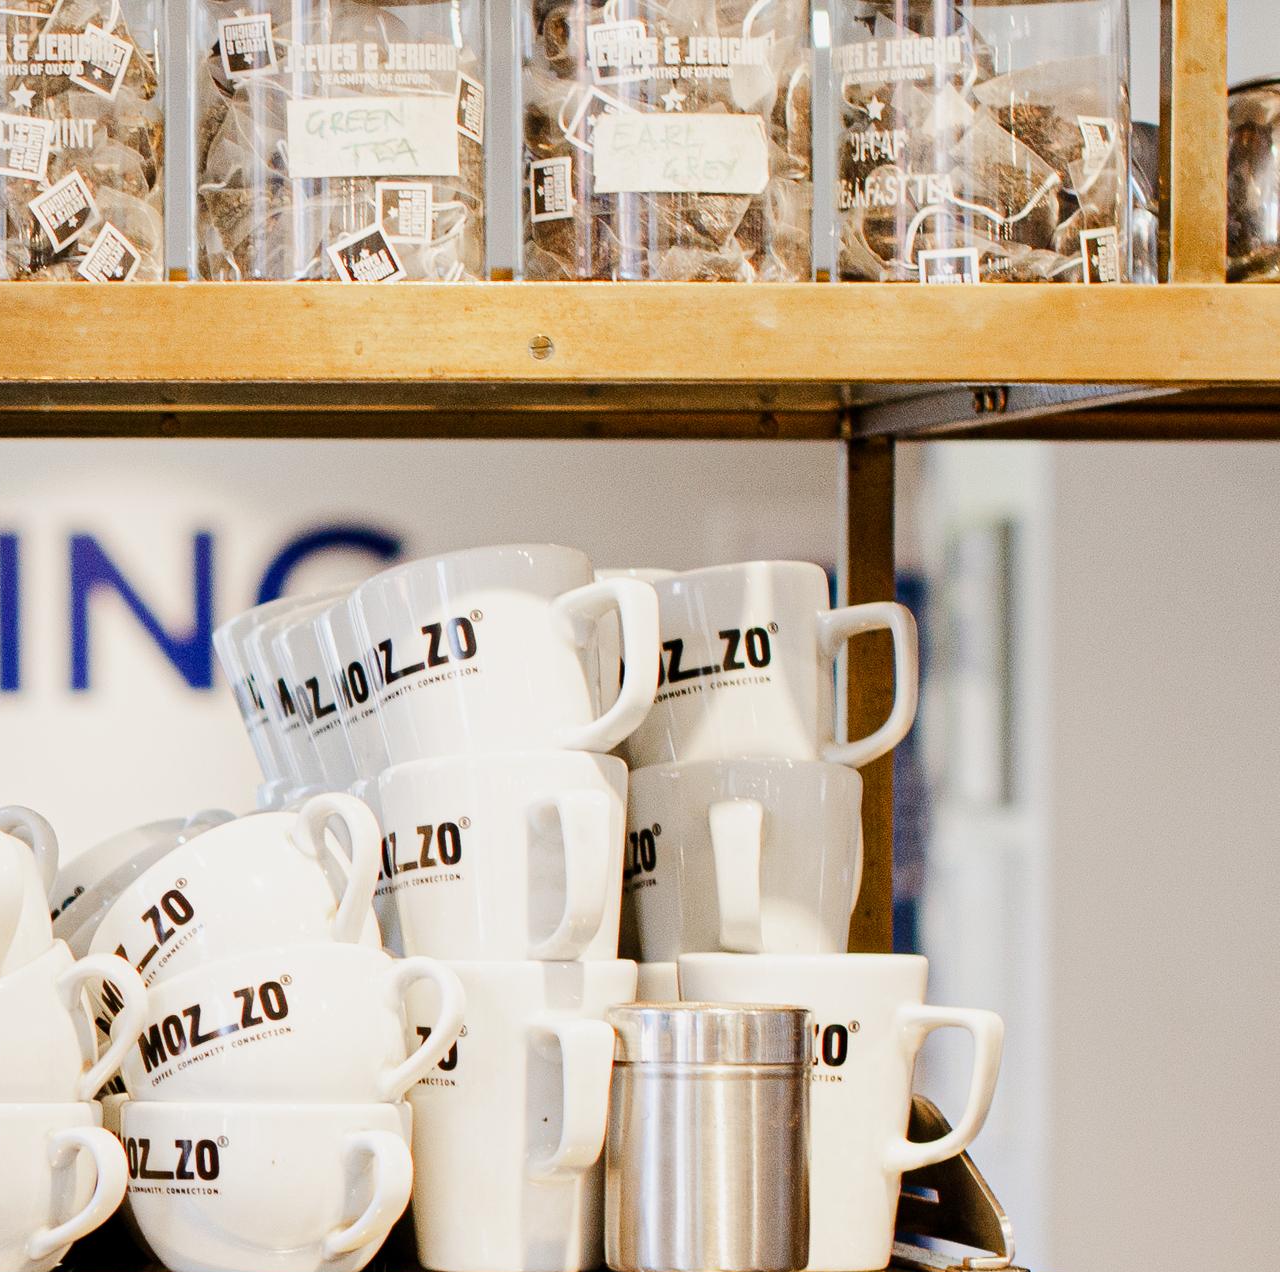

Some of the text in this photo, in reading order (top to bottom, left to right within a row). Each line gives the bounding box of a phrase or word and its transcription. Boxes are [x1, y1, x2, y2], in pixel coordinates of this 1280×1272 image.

[384, 42, 456, 70] JERICHO
[306, 109, 404, 138] GREEN
[342, 138, 419, 168] TEA
